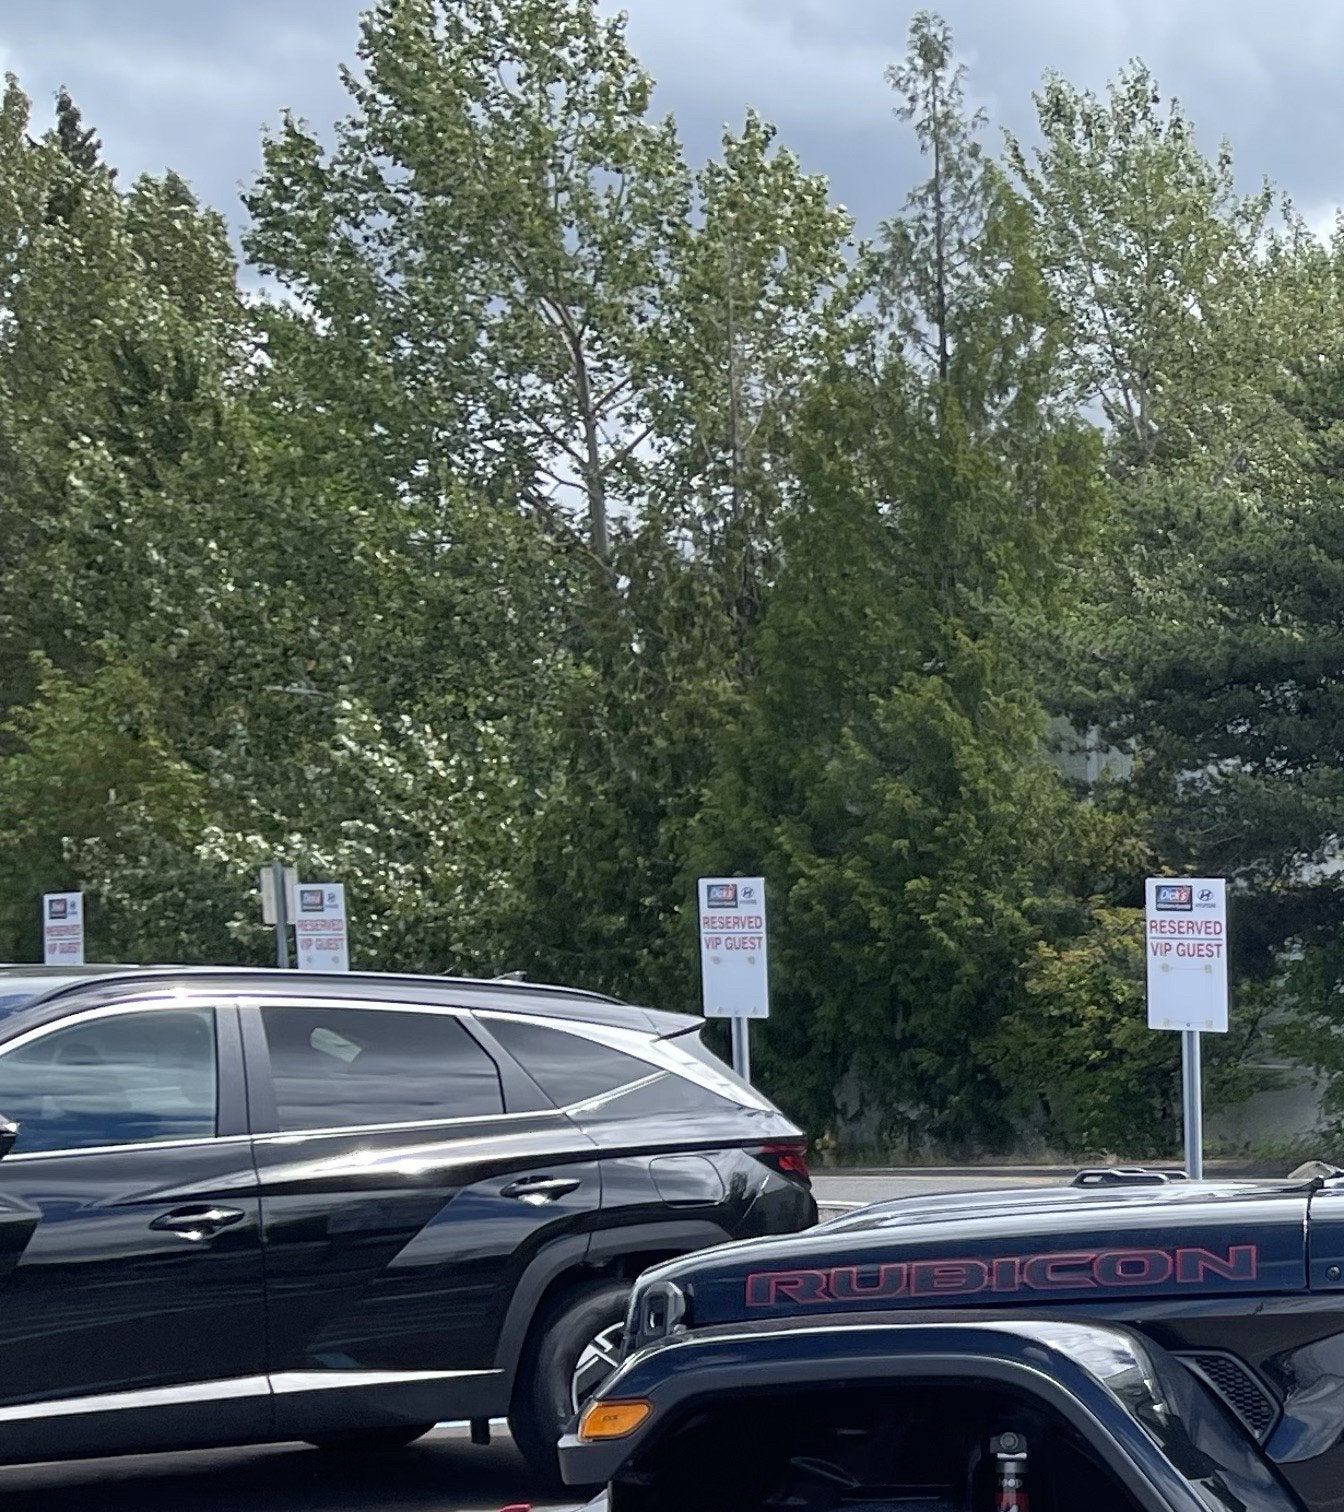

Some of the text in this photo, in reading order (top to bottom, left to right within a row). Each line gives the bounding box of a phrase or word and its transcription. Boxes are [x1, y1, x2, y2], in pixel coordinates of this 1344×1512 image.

[702, 916, 763, 929] RESERVED
[1149, 920, 1223, 935] RESERVED
[704, 936, 763, 950] VIP GUEST
[1150, 942, 1223, 958] VIP GUEST
[745, 1245, 1258, 1307] RUBICON
